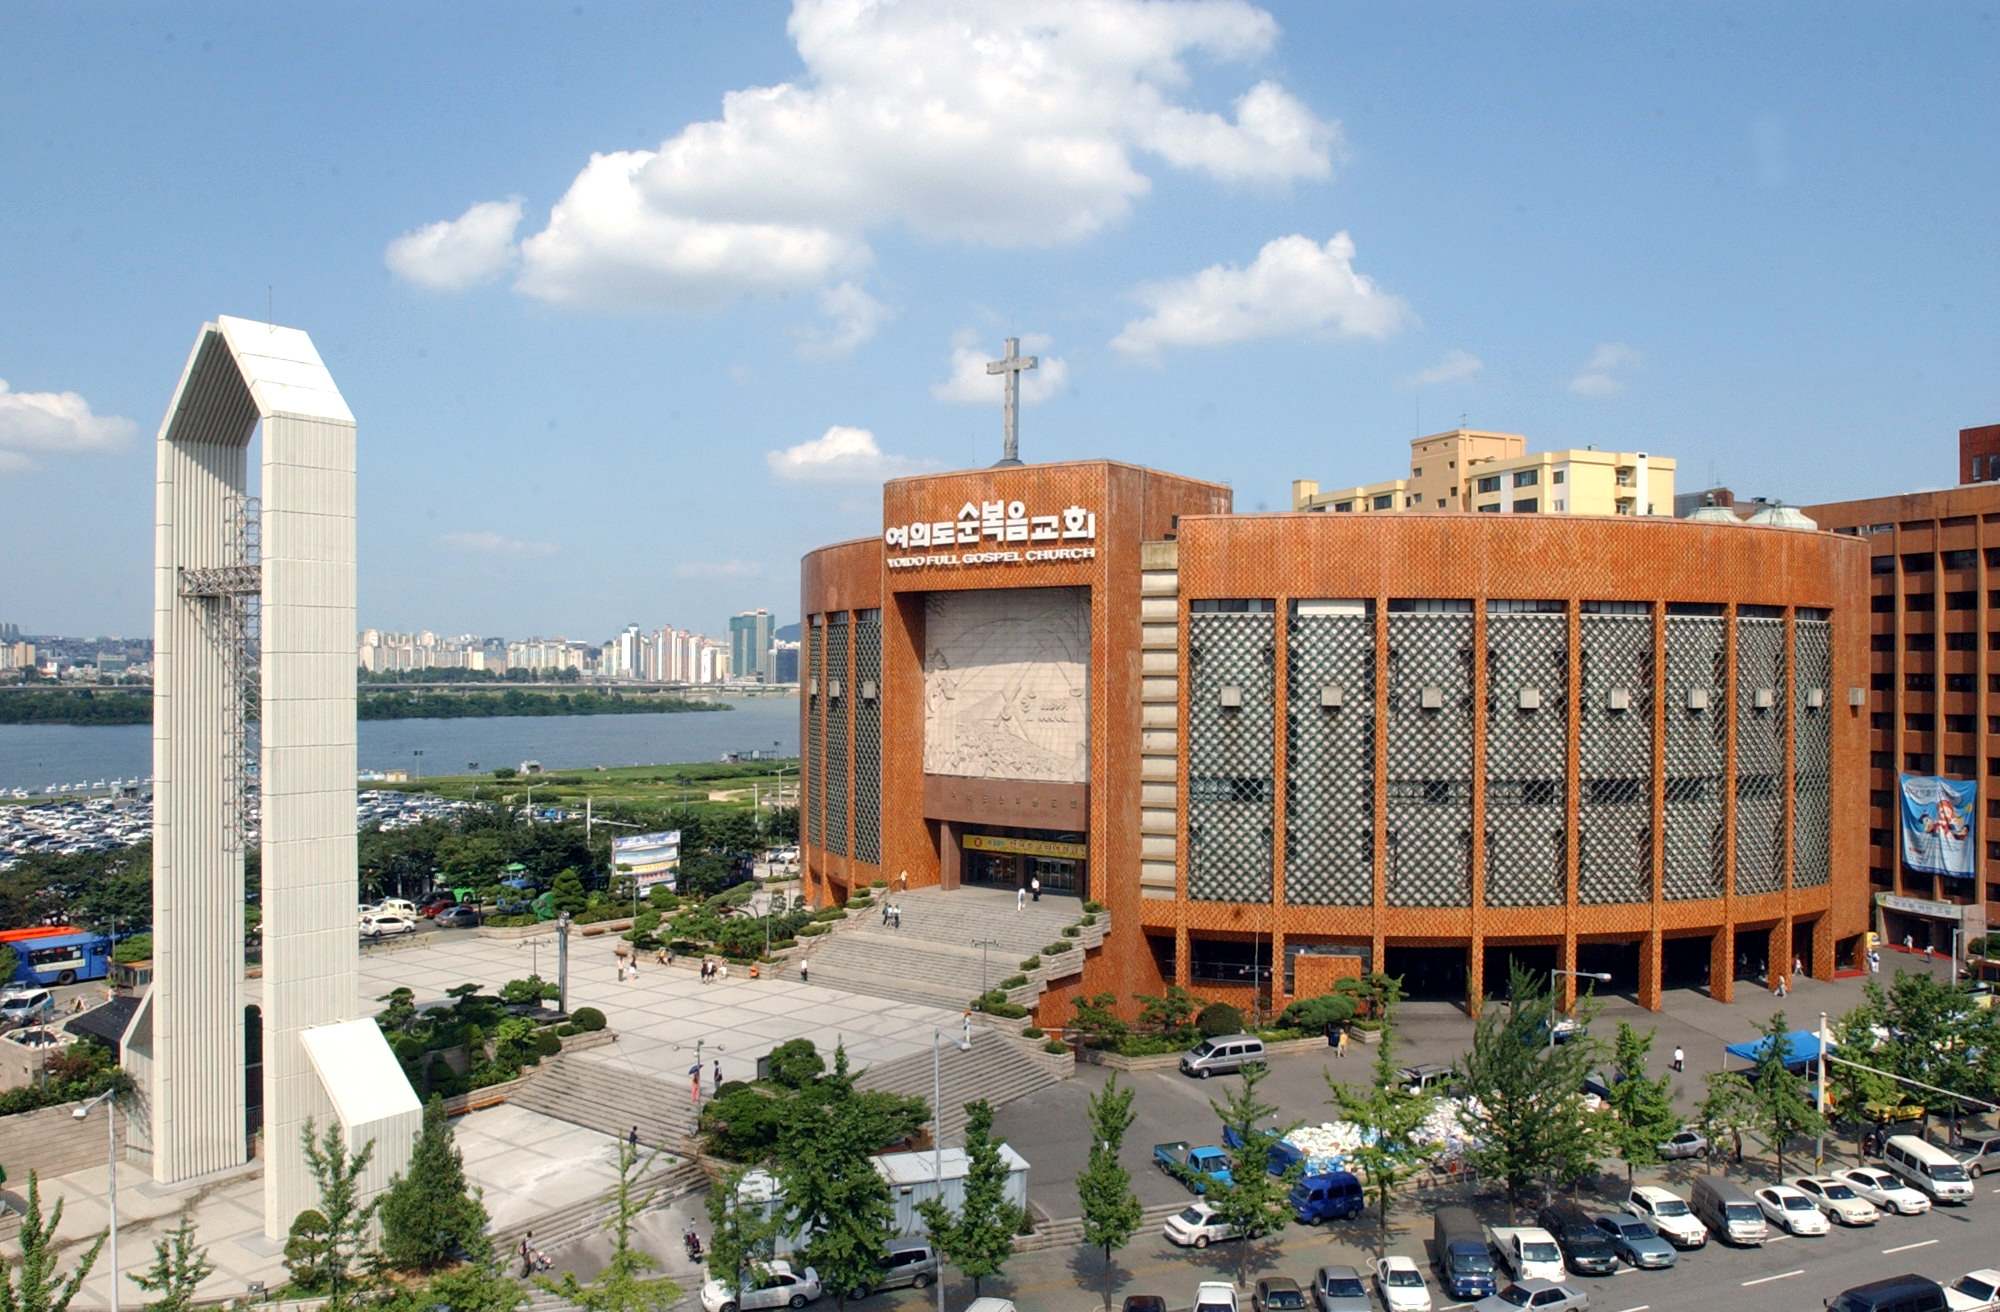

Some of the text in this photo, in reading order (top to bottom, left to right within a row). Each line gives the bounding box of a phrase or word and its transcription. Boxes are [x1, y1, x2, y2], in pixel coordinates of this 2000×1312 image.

[886, 500, 1095, 548] 여의도순복음교회
[887, 548, 1095, 568] YOIDO FULL GOSPEL CHURCH
